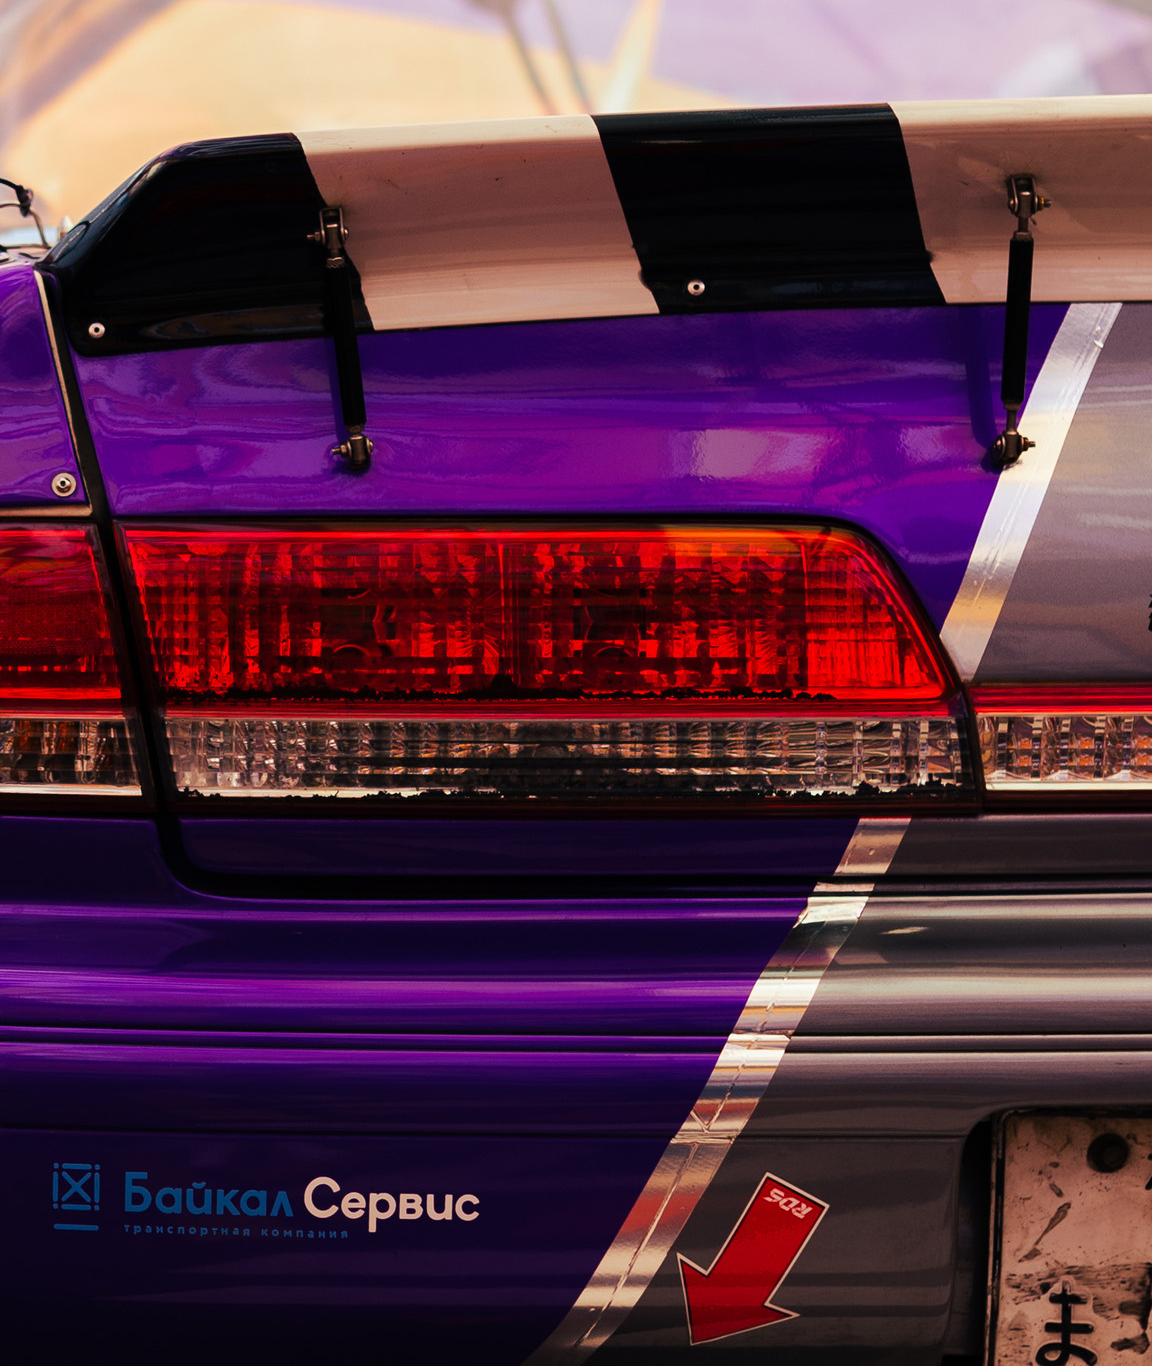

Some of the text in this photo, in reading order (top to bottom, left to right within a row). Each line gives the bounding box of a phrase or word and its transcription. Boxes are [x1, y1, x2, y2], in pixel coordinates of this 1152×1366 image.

[124, 1171, 480, 1232] Байкал Сервис
[762, 1187, 814, 1220] RDS
[123, 1223, 349, 1239] транспортная компания
